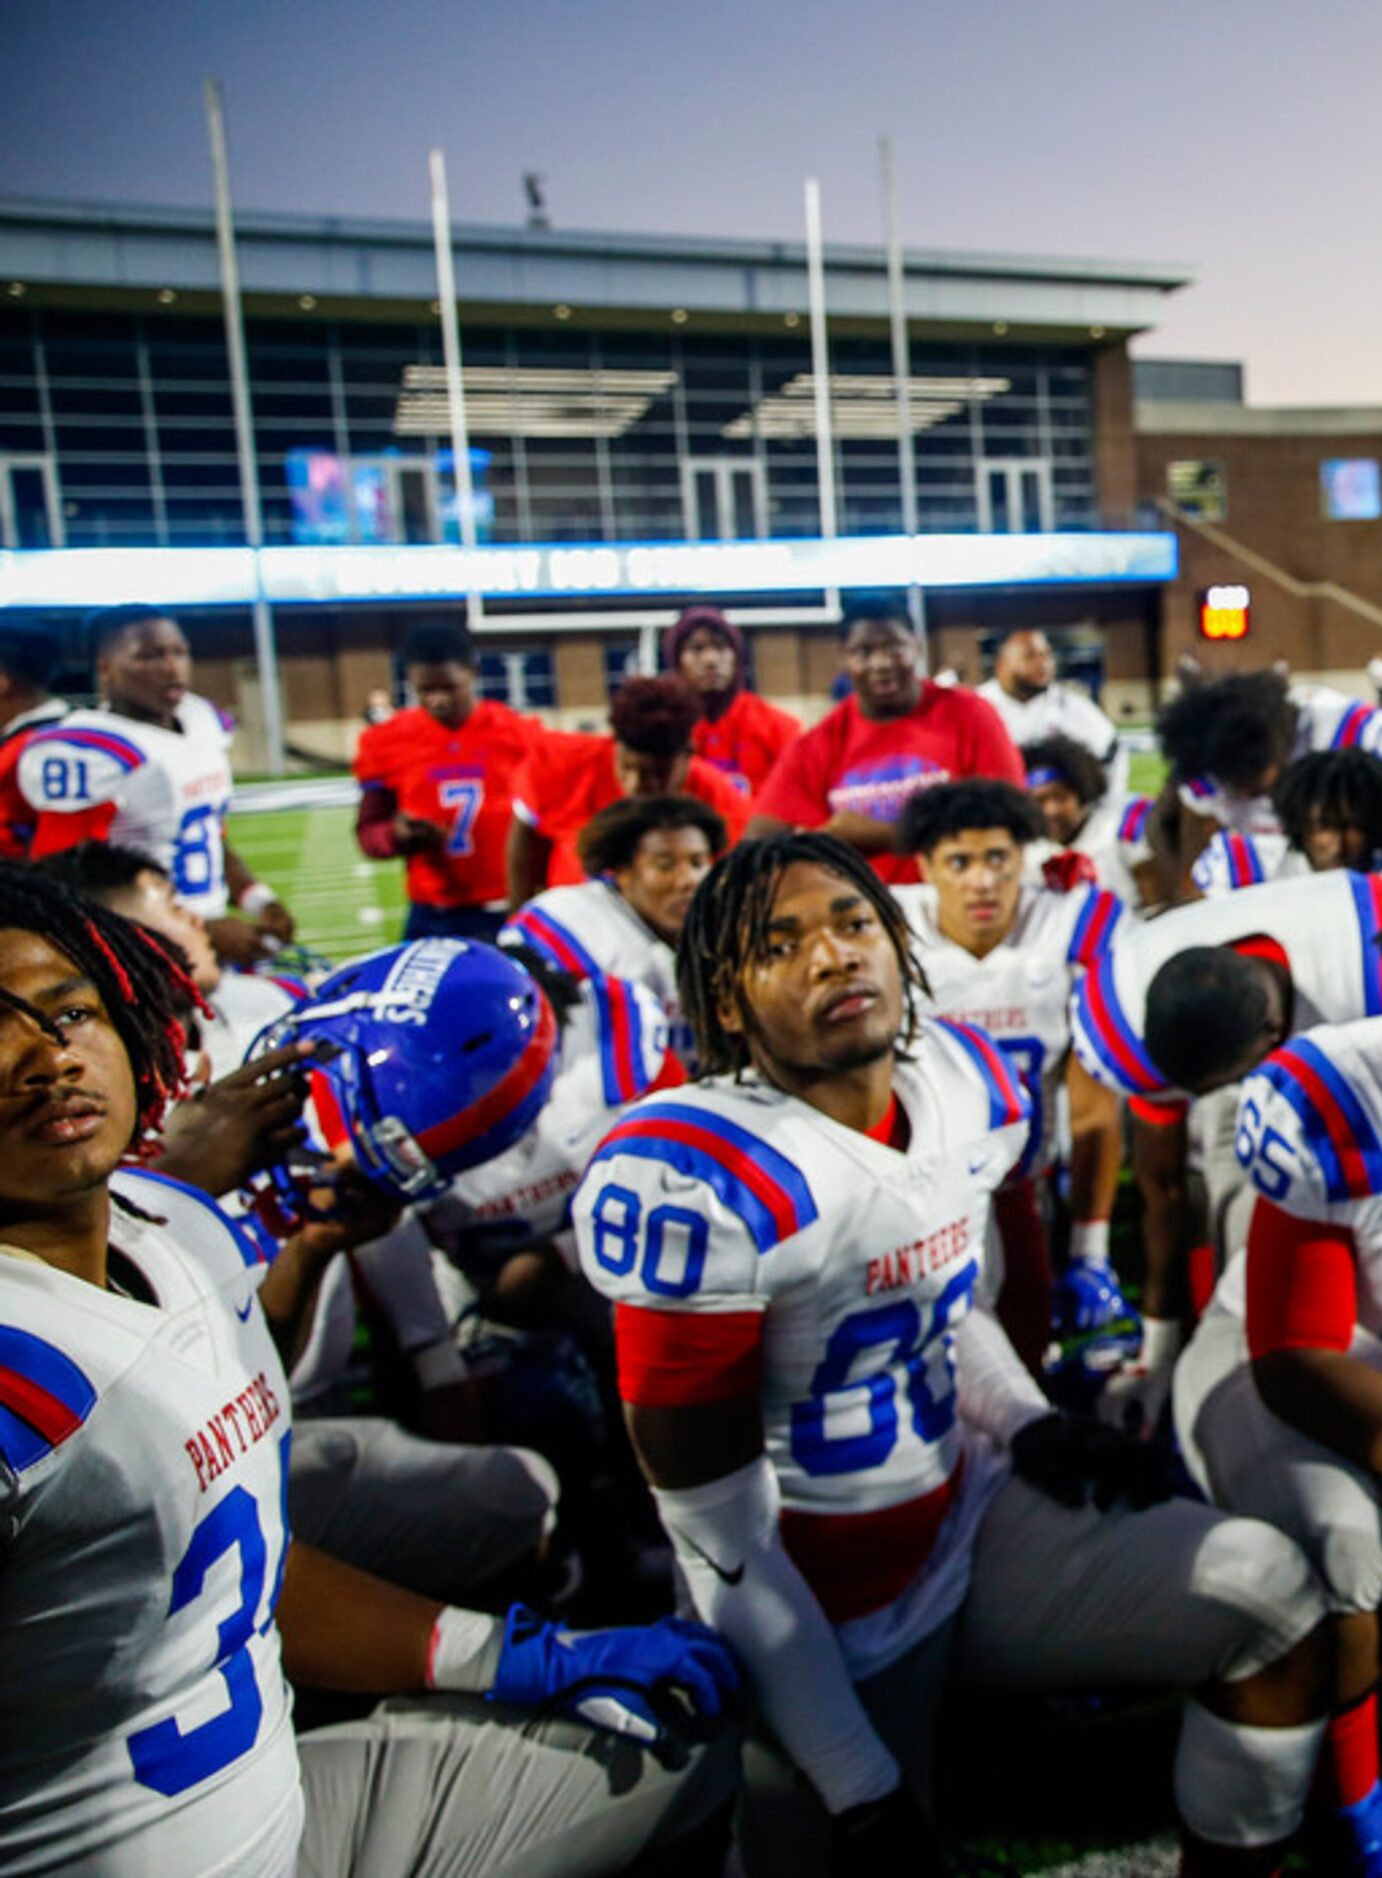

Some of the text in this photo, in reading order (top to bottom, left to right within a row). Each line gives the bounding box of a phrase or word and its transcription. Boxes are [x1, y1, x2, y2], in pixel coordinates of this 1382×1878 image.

[42, 757, 90, 800] 81
[438, 778, 486, 858] 7
[172, 803, 229, 896] 8
[1236, 1098, 1298, 1200] 65
[591, 1182, 710, 1299] 80
[790, 1257, 979, 1480] 80
[184, 1370, 280, 1493] PANTHERS
[126, 1427, 293, 1797] 3
